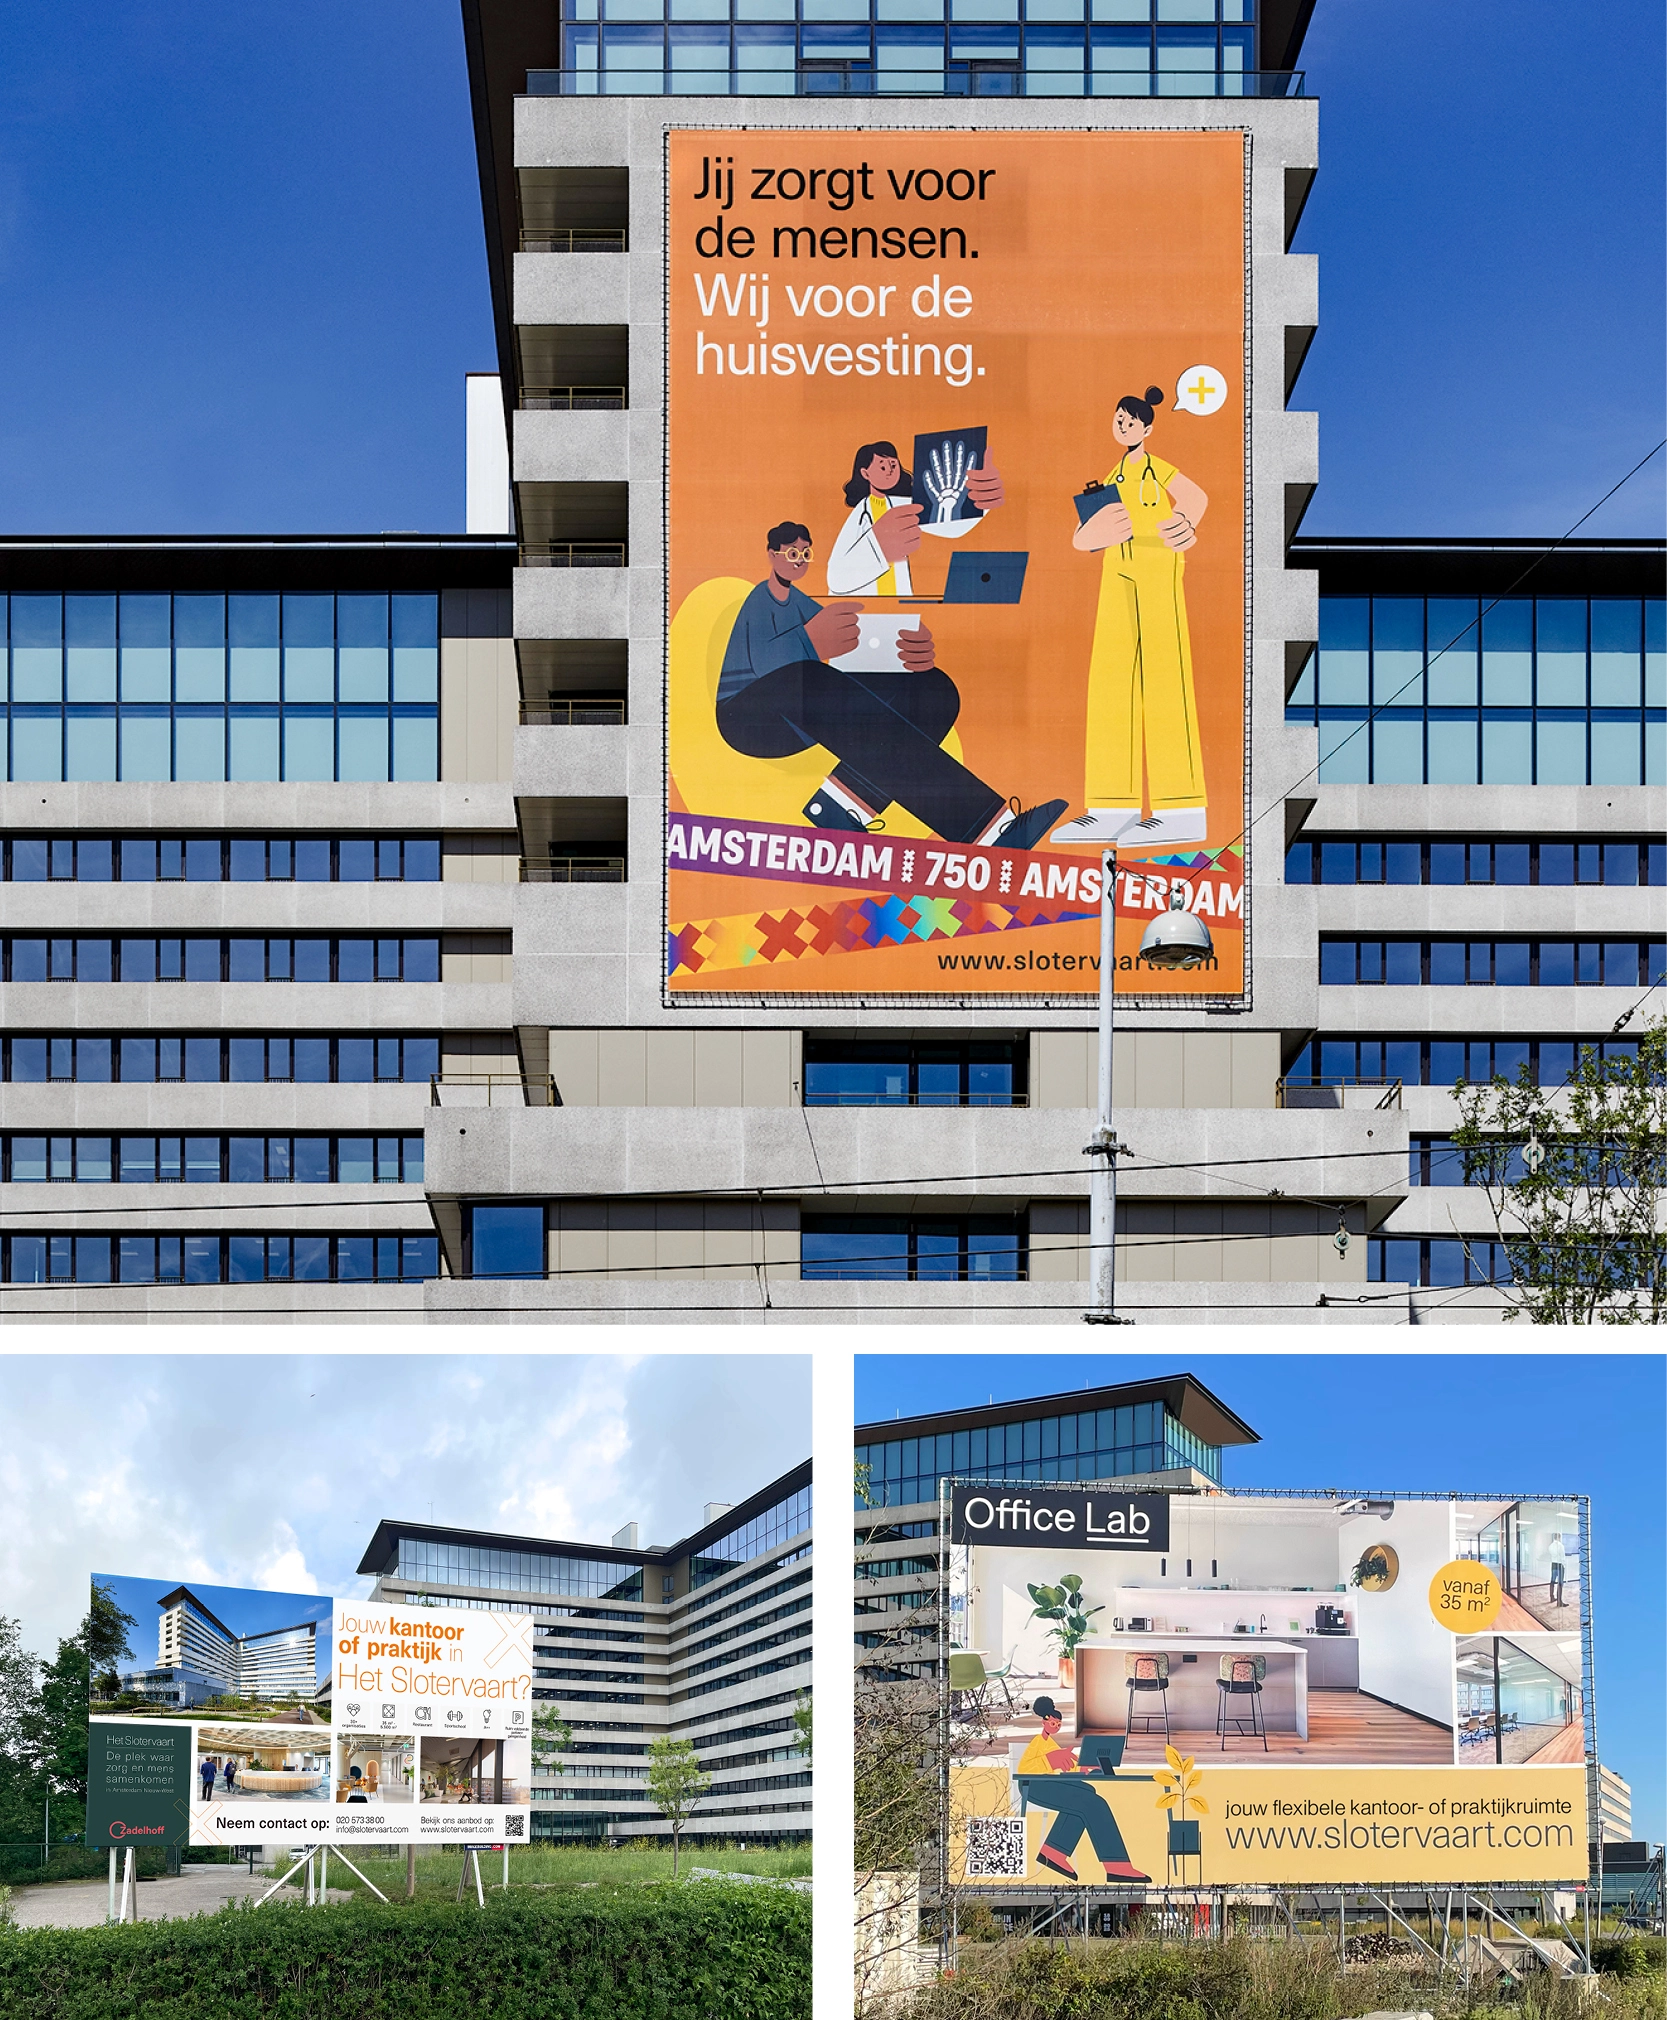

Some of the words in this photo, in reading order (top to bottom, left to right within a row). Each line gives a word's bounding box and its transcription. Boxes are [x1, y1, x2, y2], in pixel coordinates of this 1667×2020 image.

[694, 157, 734, 209] Jij
[750, 161, 874, 211] zorgt
[887, 168, 996, 201] voor
[694, 215, 754, 259] de
[773, 225, 979, 259] mensen.
[693, 273, 769, 327] Wij
[786, 283, 896, 318] voor
[911, 274, 973, 318] de
[695, 331, 986, 387] huisvesting.
[668, 823, 893, 881] AMSTERDAM
[924, 851, 991, 891] 750
[965, 1497, 1075, 1532] Office
[1086, 1502, 1150, 1535] Lab
[1443, 1580, 1491, 1595] vanaf
[1440, 1593, 1462, 1610] 35
[1467, 1596, 1491, 1612] m²
[339, 1612, 386, 1634] Jouw
[390, 1617, 464, 1640] kantoor
[338, 1636, 360, 1654] of
[367, 1640, 442, 1664] praktijk
[449, 1644, 463, 1662] in
[338, 1662, 383, 1692] Het
[391, 1666, 532, 1700] Slotervaart?
[106, 1735, 124, 1745] Het
[124, 1736, 174, 1746] Slotervaart
[106, 1751, 121, 1760] De
[125, 1752, 146, 1762] plek
[106, 1765, 128, 1774] zorg
[147, 1765, 174, 1773] mens
[106, 1775, 174, 1784] samenkomen
[1225, 1800, 1268, 1819] jouw
[1272, 1799, 1346, 1816] flexibele
[1350, 1799, 1424, 1815] kantoor-
[1429, 1798, 1448, 1815] of
[1450, 1798, 1572, 1818] praktijkruimte
[216, 1817, 255, 1829] Neem
[259, 1818, 307, 1829] contact
[310, 1820, 330, 1831] op:
[336, 1816, 350, 1824] 020
[336, 1825, 409, 1834] info@slotervaart.com
[420, 1816, 441, 1826] Bekijk
[484, 1818, 495, 1826] op:
[420, 1826, 495, 1834] www.slotervaart.com
[1225, 1818, 1573, 1850] www.slotervaart.com
